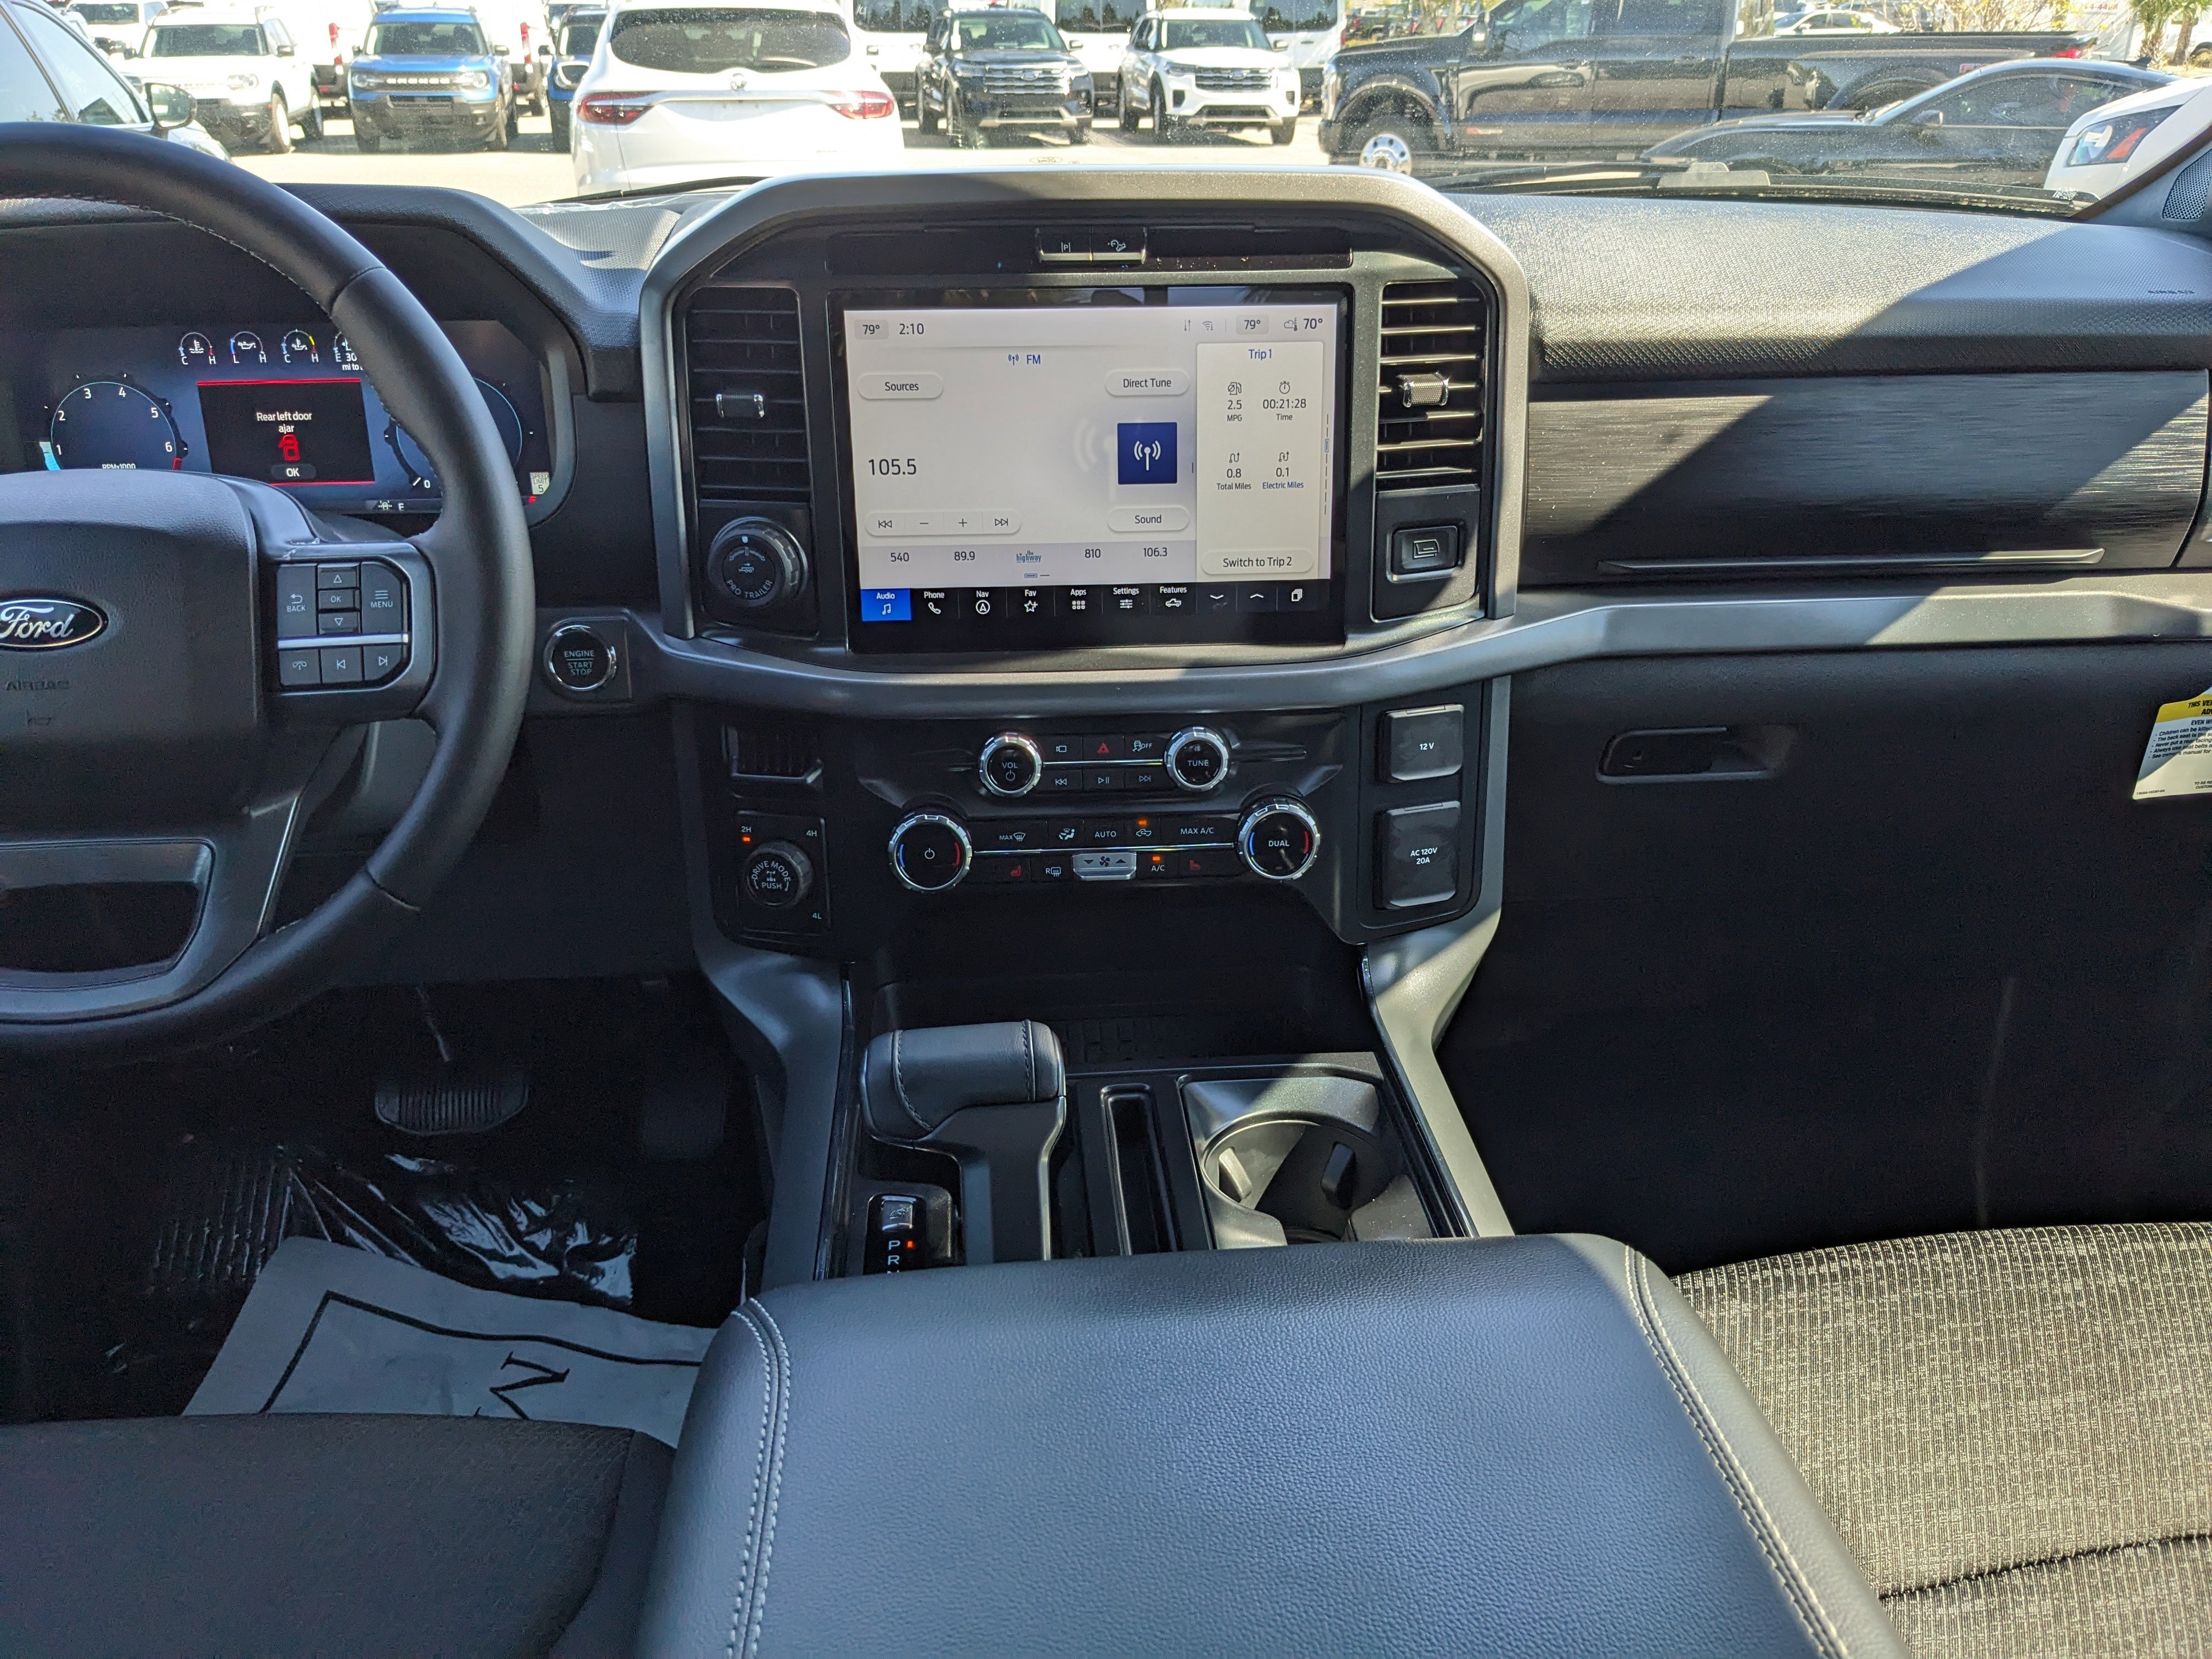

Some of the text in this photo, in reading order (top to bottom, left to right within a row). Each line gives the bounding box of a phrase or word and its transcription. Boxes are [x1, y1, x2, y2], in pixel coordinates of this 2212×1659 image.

[1244, 319, 1261, 330] 79°
[1304, 318, 1323, 329] 70°
[863, 324, 880, 335] 79°
[899, 323, 924, 335] 2:10
[259, 354, 267, 363] H
[284, 355, 291, 363] C
[312, 354, 319, 363] H
[335, 353, 342, 362] E
[1026, 354, 1041, 364] FM
[1249, 349, 1272, 360] Trip 1
[182, 357, 188, 365] C
[209, 356, 216, 365] H
[233, 356, 239, 364] L
[885, 382, 919, 391] Sources
[1123, 378, 1171, 388] Direct Tune
[83, 388, 92, 399] 3
[119, 387, 127, 398] 4
[1227, 400, 1242, 410] 2.5
[1262, 399, 1307, 409] 00:21:28
[58, 410, 66, 421] 2
[150, 408, 159, 418] 5
[256, 411, 313, 422] Rear left door
[278, 423, 295, 434] ajar
[56, 444, 62, 455] 1
[165, 442, 173, 453] 6
[286, 467, 300, 477] OK
[868, 459, 917, 475] 105.5
[1276, 467, 1289, 477] 0.1
[1227, 469, 1242, 478] 0.8
[424, 479, 431, 488] 0
[538, 484, 544, 493] 5
[1135, 515, 1161, 524] Sound
[890, 552, 909, 562] 540
[954, 551, 975, 561] 89.9
[1085, 549, 1101, 558] 810
[1143, 548, 1167, 557] 106.3
[1016, 554, 1042, 563] highway
[1223, 556, 1292, 568] Switch to Trip 2
[727, 579, 773, 599] PRO TRAILER
[1071, 589, 1086, 597] Apps
[1113, 586, 1139, 595] Settings
[1160, 586, 1187, 594] Features
[924, 591, 945, 599] Phone
[286, 603, 306, 612] BACK
[370, 600, 393, 608] MENU
[0, 606, 75, 639] Ford
[1429, 742, 1435, 750] V
[1421, 847, 1438, 855] 120V
[751, 860, 791, 882] DRIVE MODE
[888, 1240, 901, 1251] P
[887, 1255, 900, 1266] R
